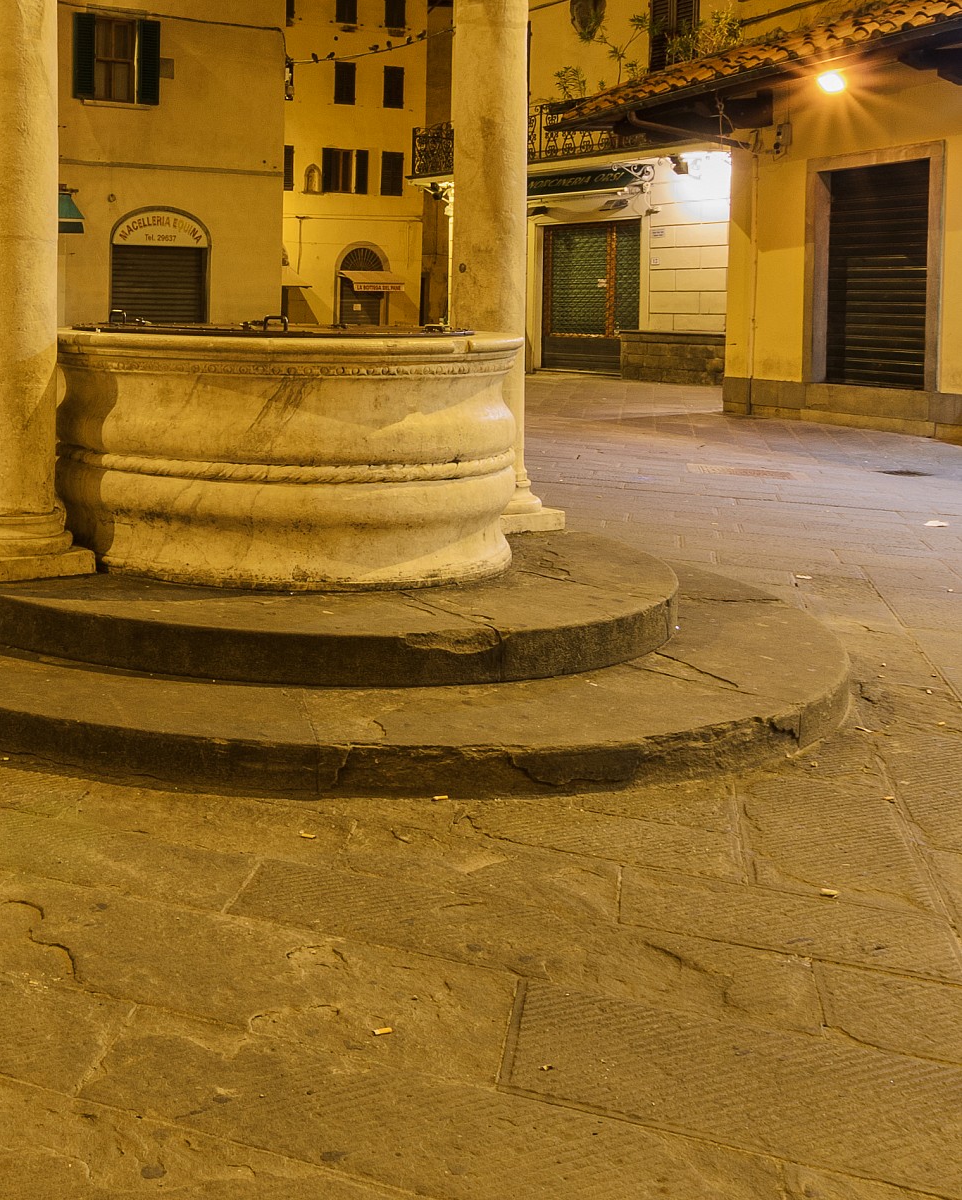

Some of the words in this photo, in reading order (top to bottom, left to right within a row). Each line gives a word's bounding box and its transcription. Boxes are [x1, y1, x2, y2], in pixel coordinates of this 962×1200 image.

[595, 172, 624, 182] ORSI
[119, 215, 171, 241] MACELLERIA
[172, 217, 203, 244] EQUINA
